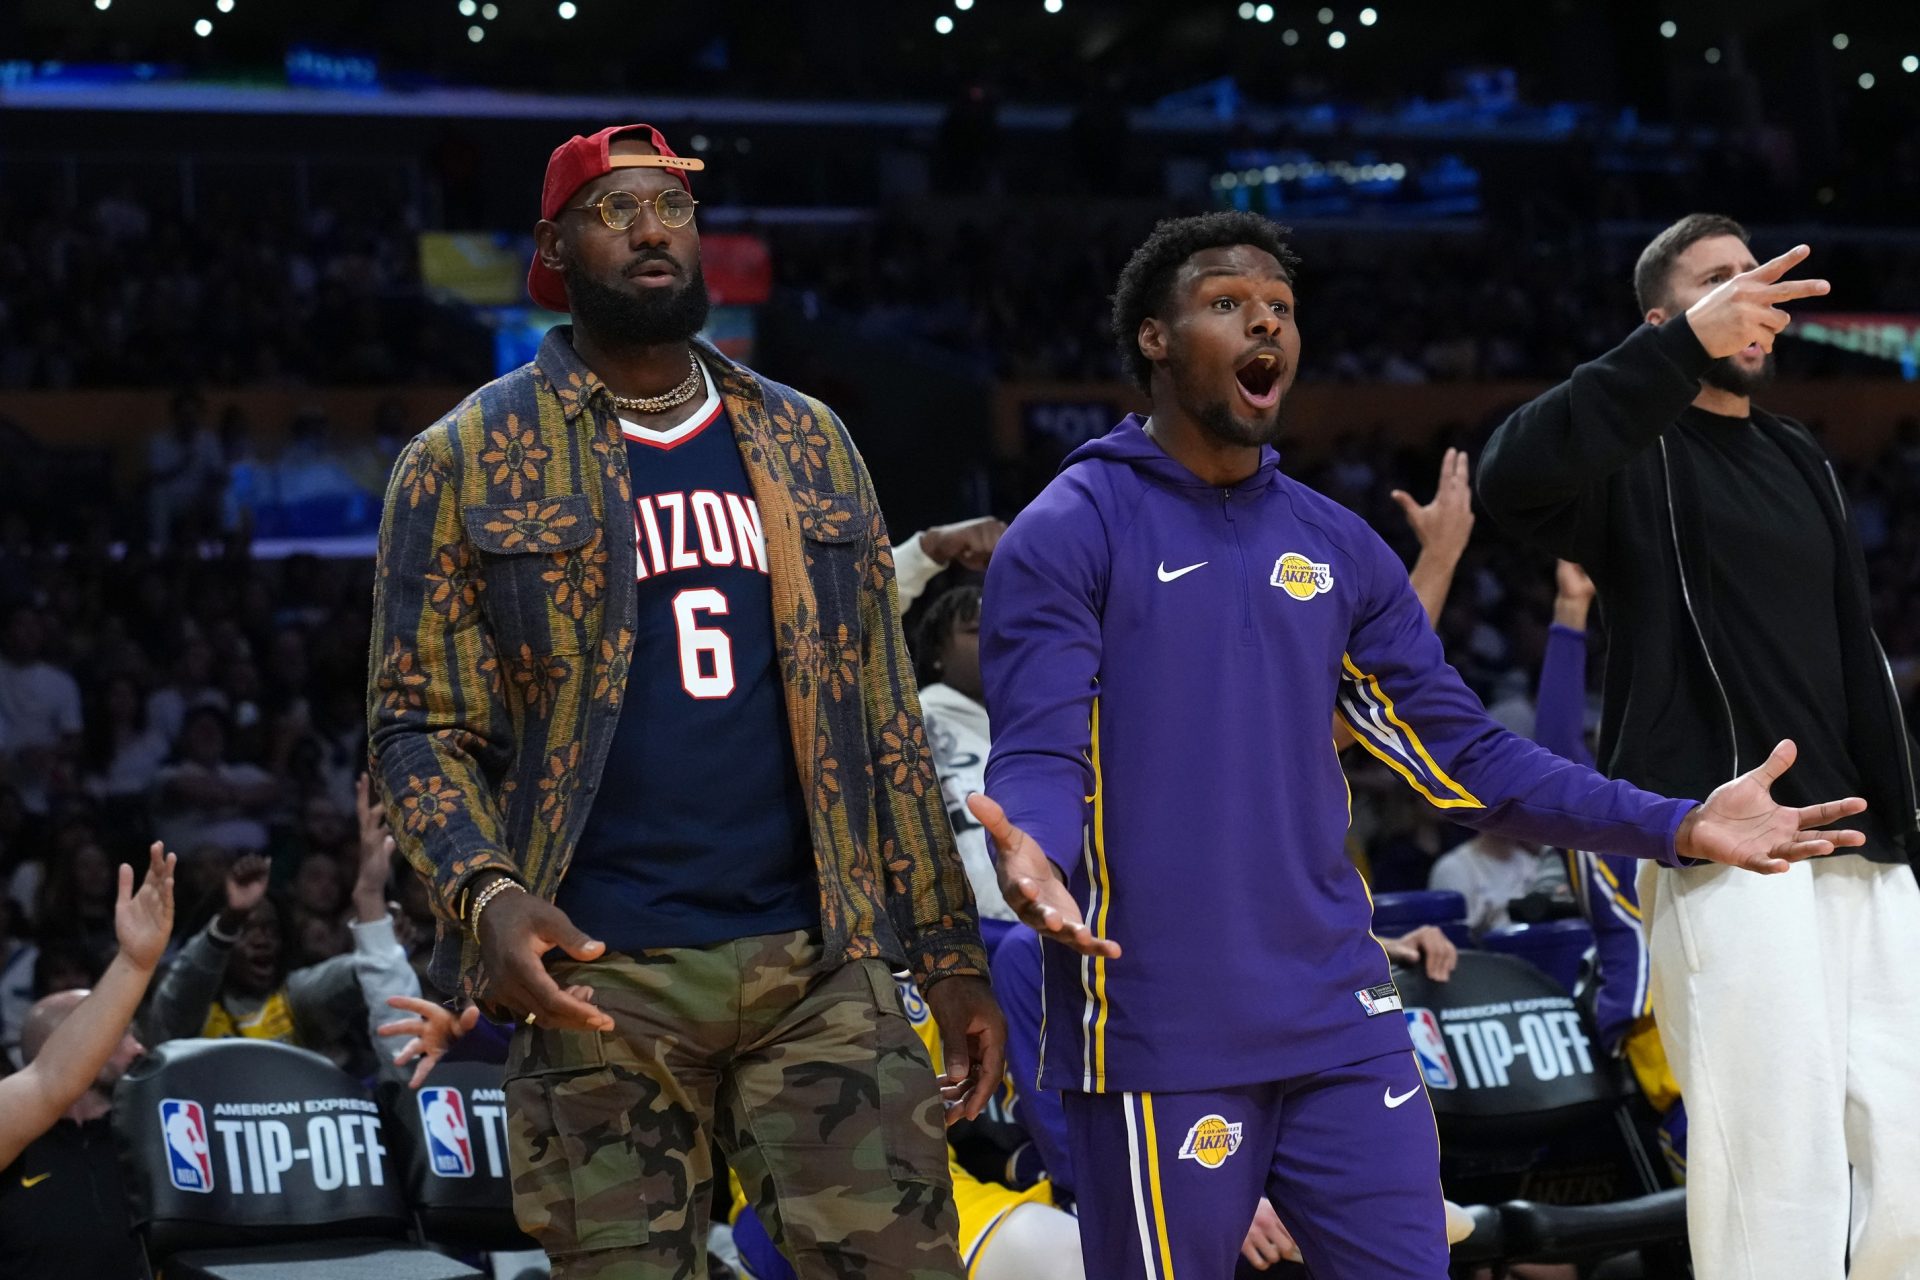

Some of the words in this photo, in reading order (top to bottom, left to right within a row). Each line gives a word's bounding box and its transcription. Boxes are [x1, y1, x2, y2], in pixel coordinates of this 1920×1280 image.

[1274, 563, 1331, 590] LAKERS
[671, 587, 736, 699] 6
[1443, 1011, 1594, 1089] TIP-OFF
[213, 1101, 301, 1117] AMERICAN
[303, 1097, 379, 1114] EXPRESS
[213, 1115, 387, 1194] TIP-OFF
[1184, 1130, 1240, 1155] LAKERS
